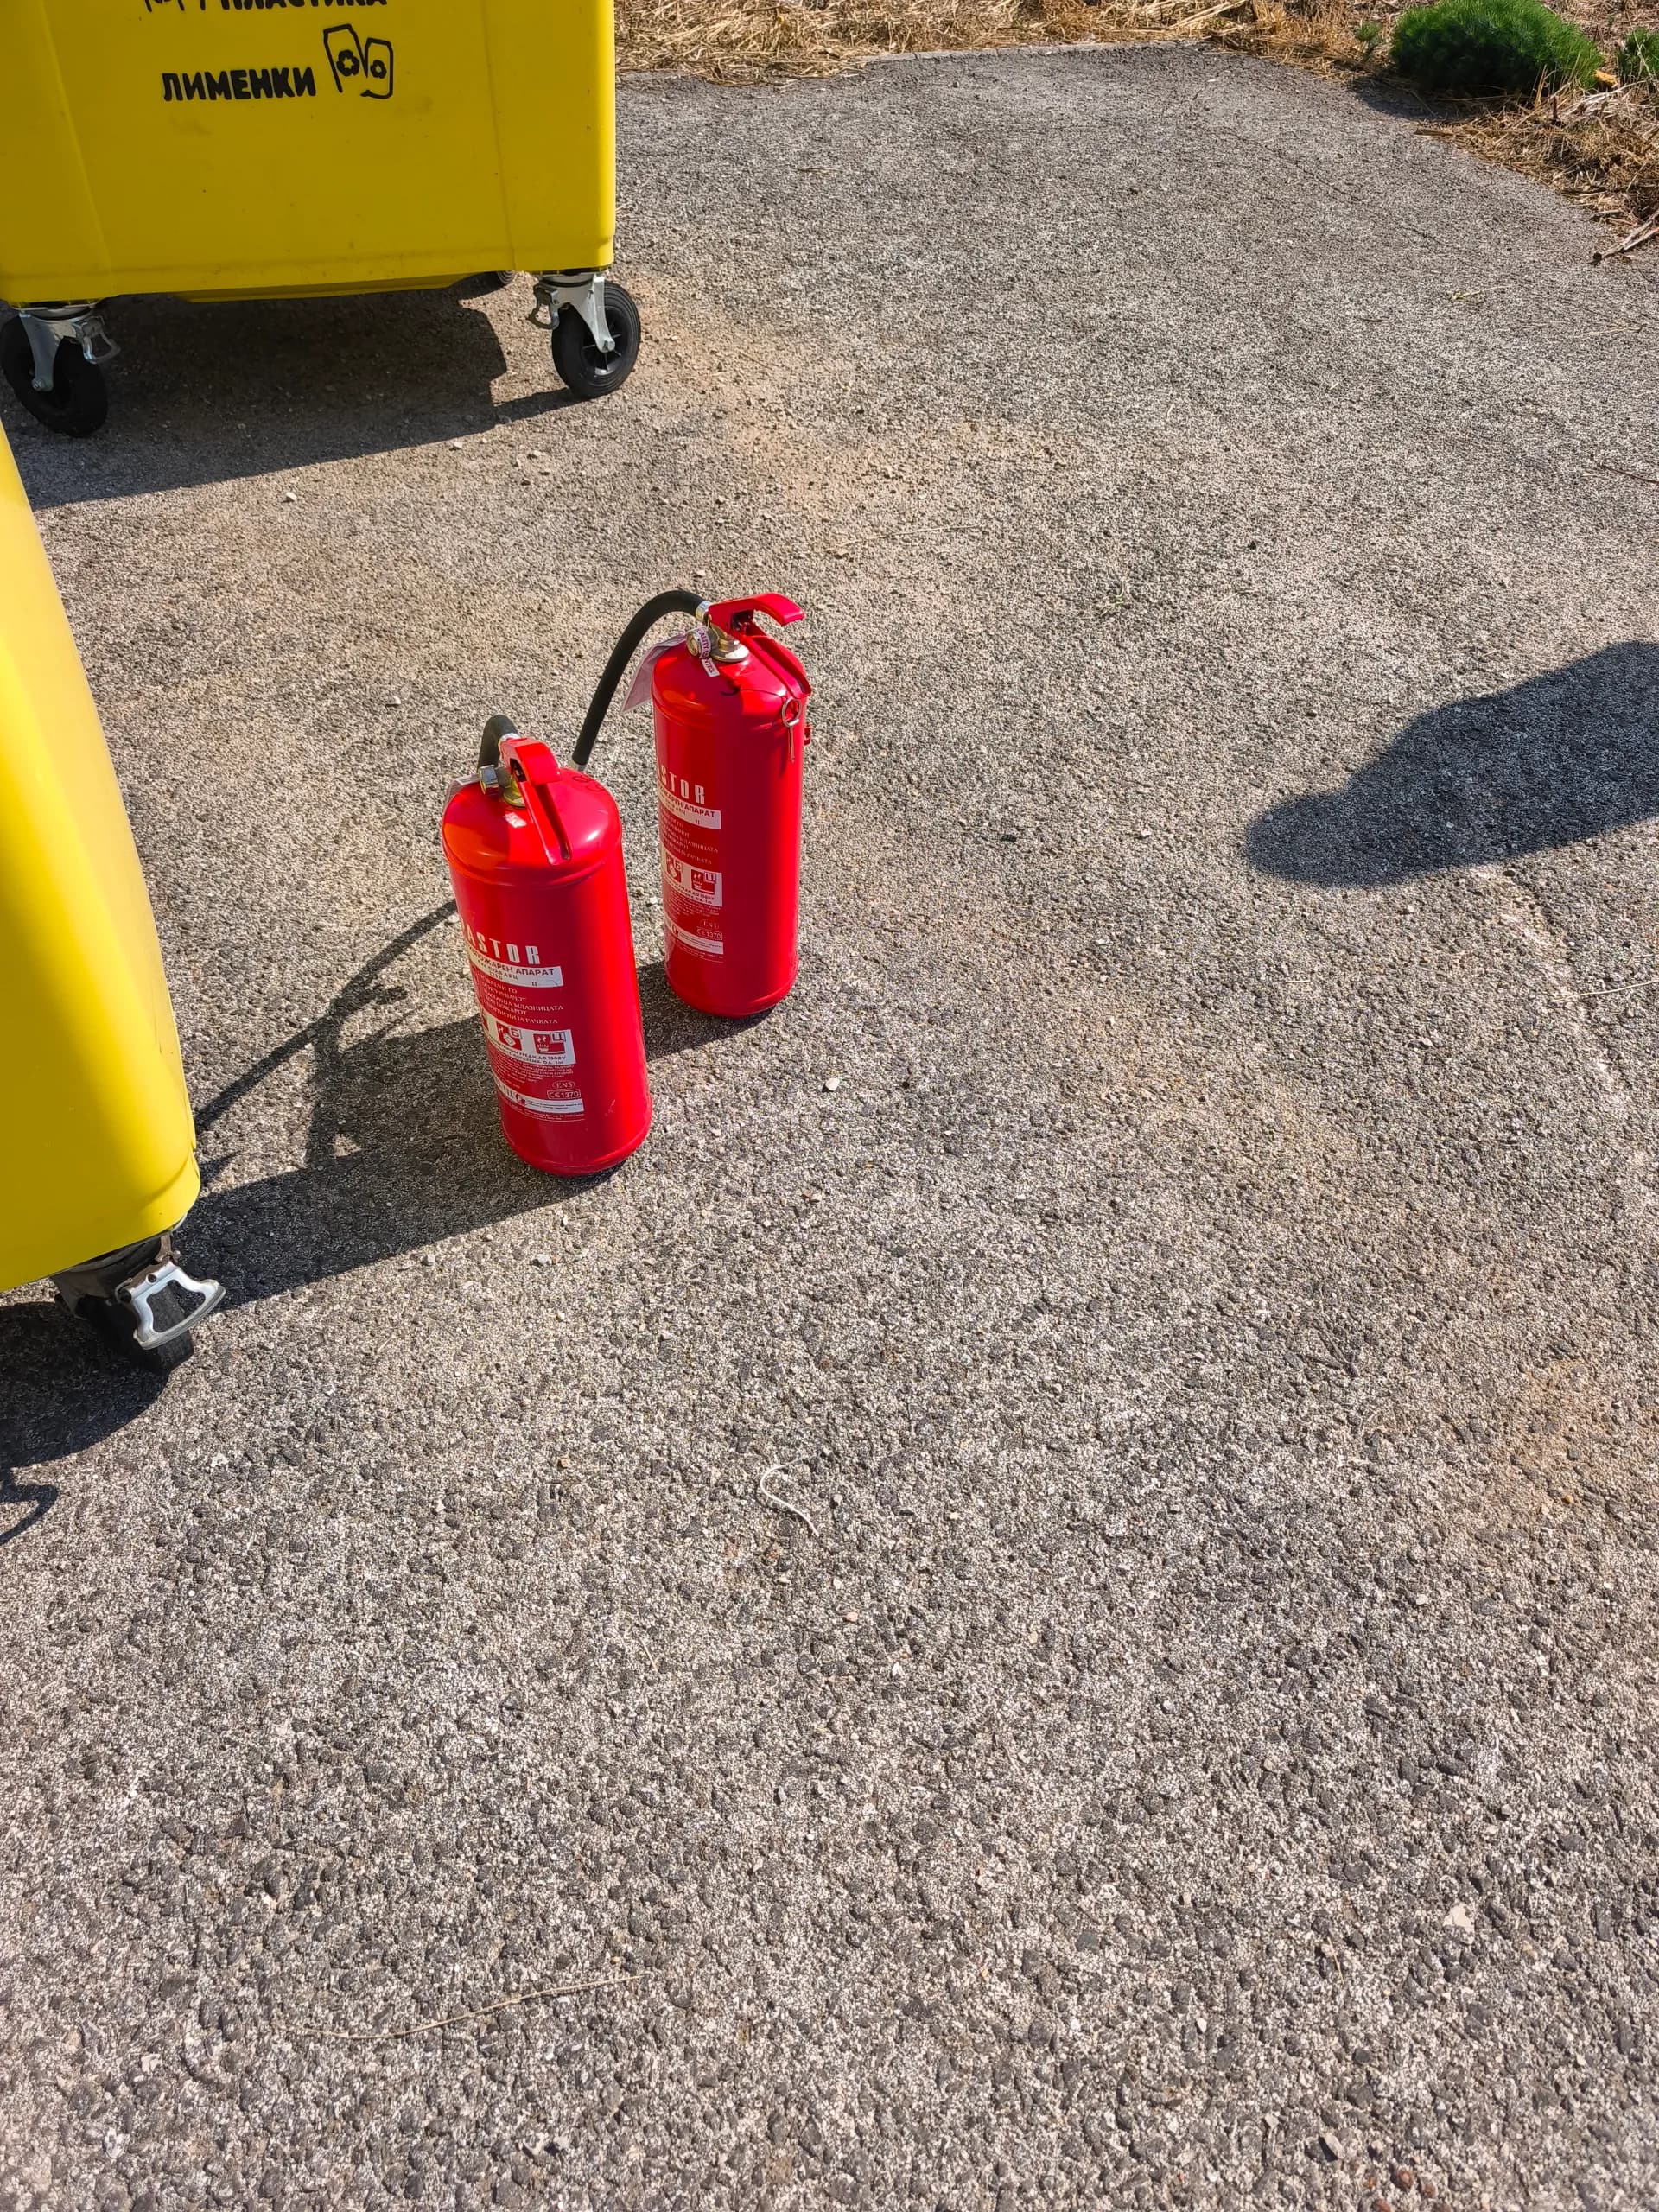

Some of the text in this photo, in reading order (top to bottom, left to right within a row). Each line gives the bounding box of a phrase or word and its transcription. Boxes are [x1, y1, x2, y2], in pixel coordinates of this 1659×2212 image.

[162, 67, 316, 101] ЛИМЕНКИ
[516, 968, 554, 976] АПАРАТ
[510, 1028, 519, 1037] Б
[553, 1033, 564, 1043] Ц
